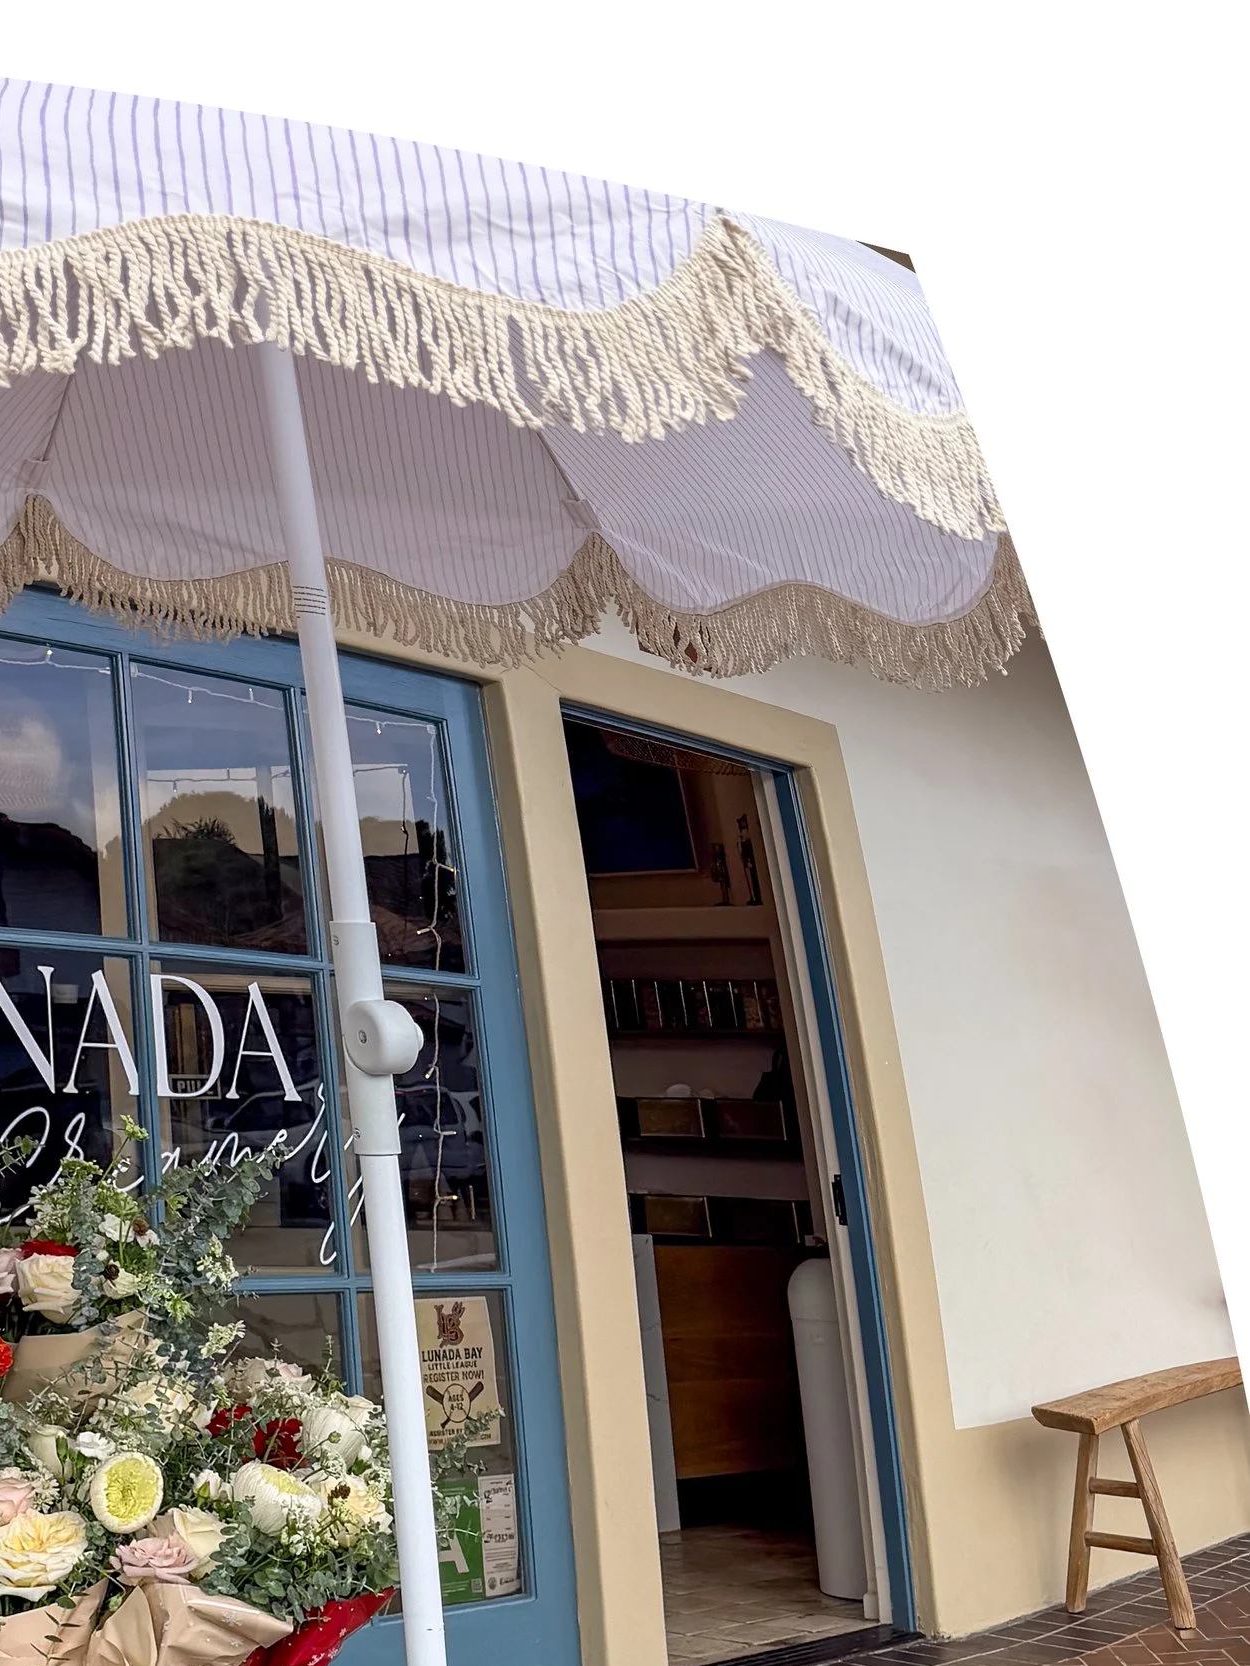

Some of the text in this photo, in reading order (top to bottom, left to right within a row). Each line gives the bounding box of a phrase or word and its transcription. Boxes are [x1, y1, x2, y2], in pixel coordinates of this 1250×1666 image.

[421, 1346, 483, 1362] LUNADA BAY
[427, 1360, 478, 1371] LITTLE LEAGUE
[423, 1369, 485, 1383] REGISTER NOW!
[448, 1393, 465, 1402] AGES
